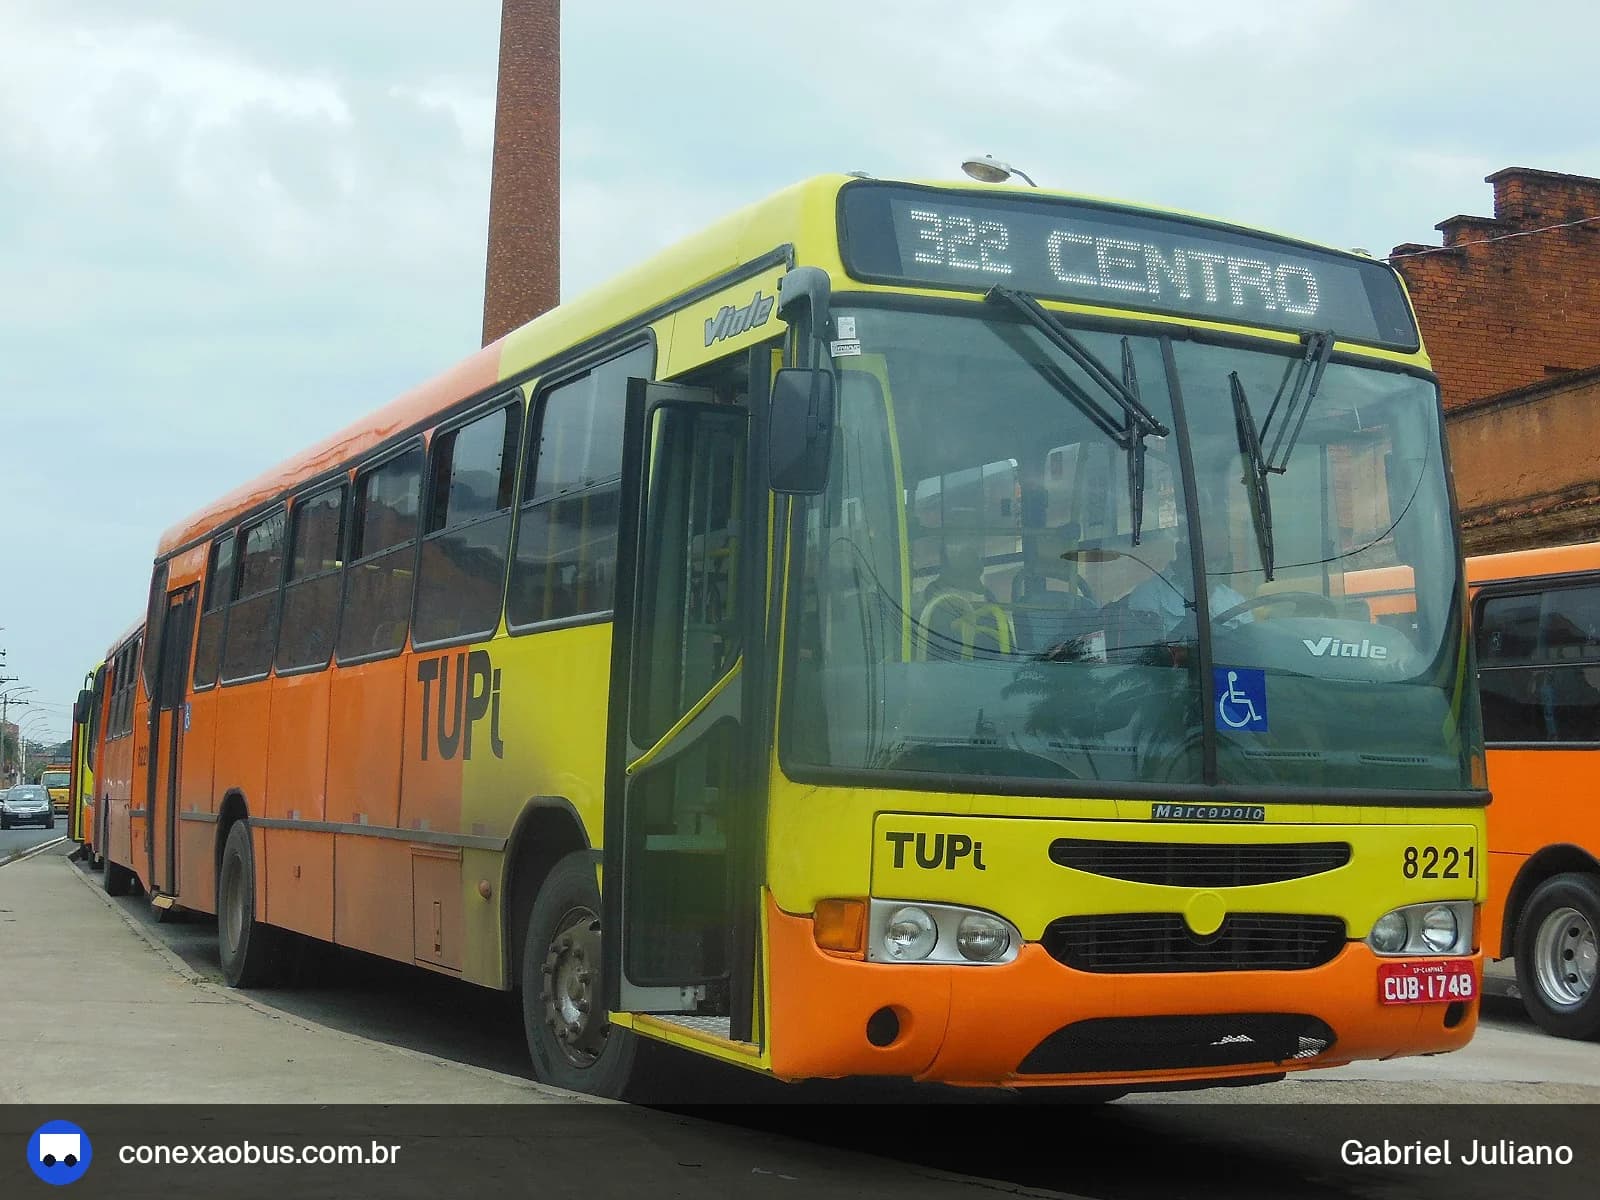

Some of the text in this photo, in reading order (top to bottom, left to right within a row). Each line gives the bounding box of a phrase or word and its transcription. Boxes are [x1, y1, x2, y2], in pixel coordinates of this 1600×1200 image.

[911, 210, 1320, 315] 322 CENTRO
[704, 290, 775, 347] Viale
[1302, 636, 1387, 659] Viale
[1155, 804, 1263, 820] Marcopolo
[1402, 846, 1474, 879] 8221
